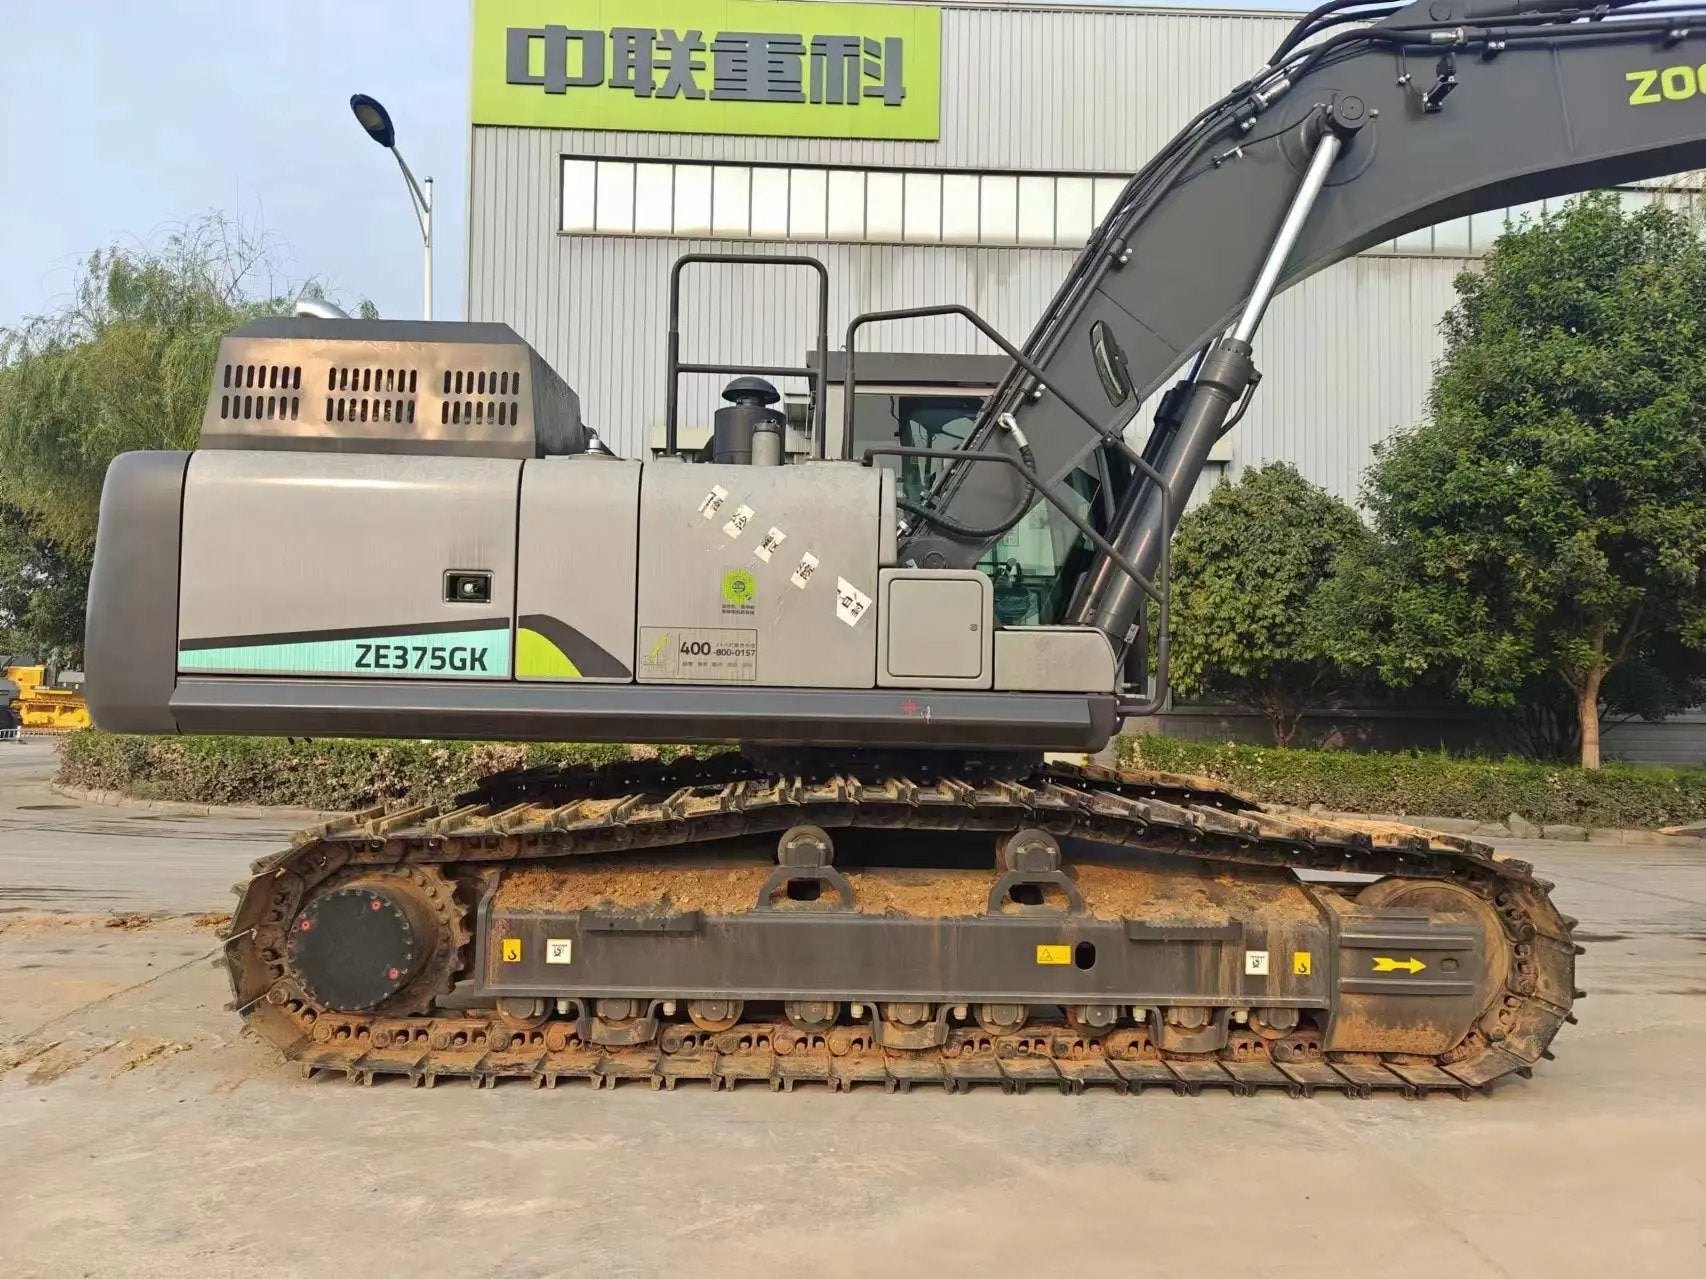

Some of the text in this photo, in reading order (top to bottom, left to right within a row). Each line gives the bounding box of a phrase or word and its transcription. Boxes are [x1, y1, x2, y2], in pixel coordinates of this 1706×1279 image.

[505, 25, 906, 106] 中联重科
[1625, 64, 1706, 105] ZO
[354, 644, 488, 672] ZE375GK
[680, 641, 711, 656] 400
